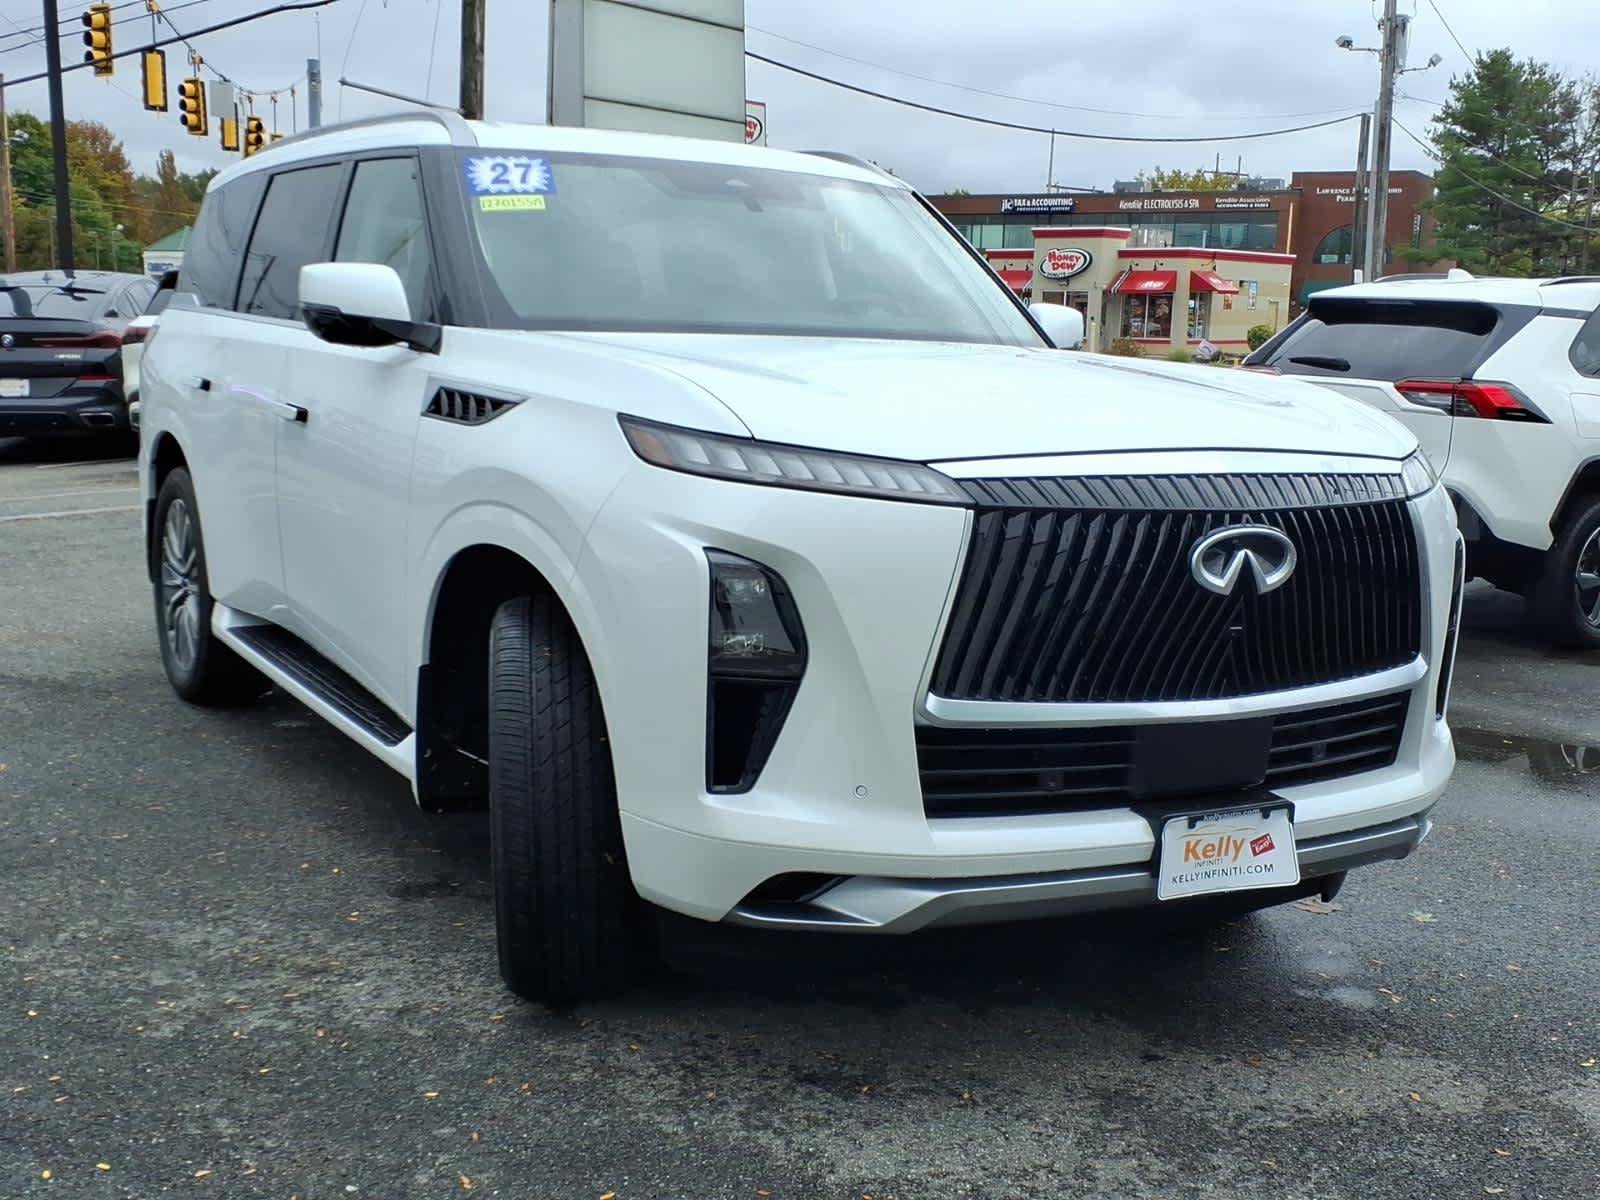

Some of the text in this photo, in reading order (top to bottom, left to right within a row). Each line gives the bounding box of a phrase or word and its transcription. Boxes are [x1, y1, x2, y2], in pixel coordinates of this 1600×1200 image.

[490, 162, 532, 185] 27
[1014, 198, 1026, 207] TAX
[1032, 198, 1073, 207] ACCOUNTING
[1144, 199, 1184, 209] ELECTROLYSIS
[1189, 199, 1200, 209] SPA
[1048, 250, 1081, 263] HONEY
[1052, 262, 1076, 271] DEW
[1184, 835, 1246, 863] Kelly
[1194, 858, 1223, 868] INFINITI
[1172, 863, 1274, 885] KELLYINFINITI.COM
